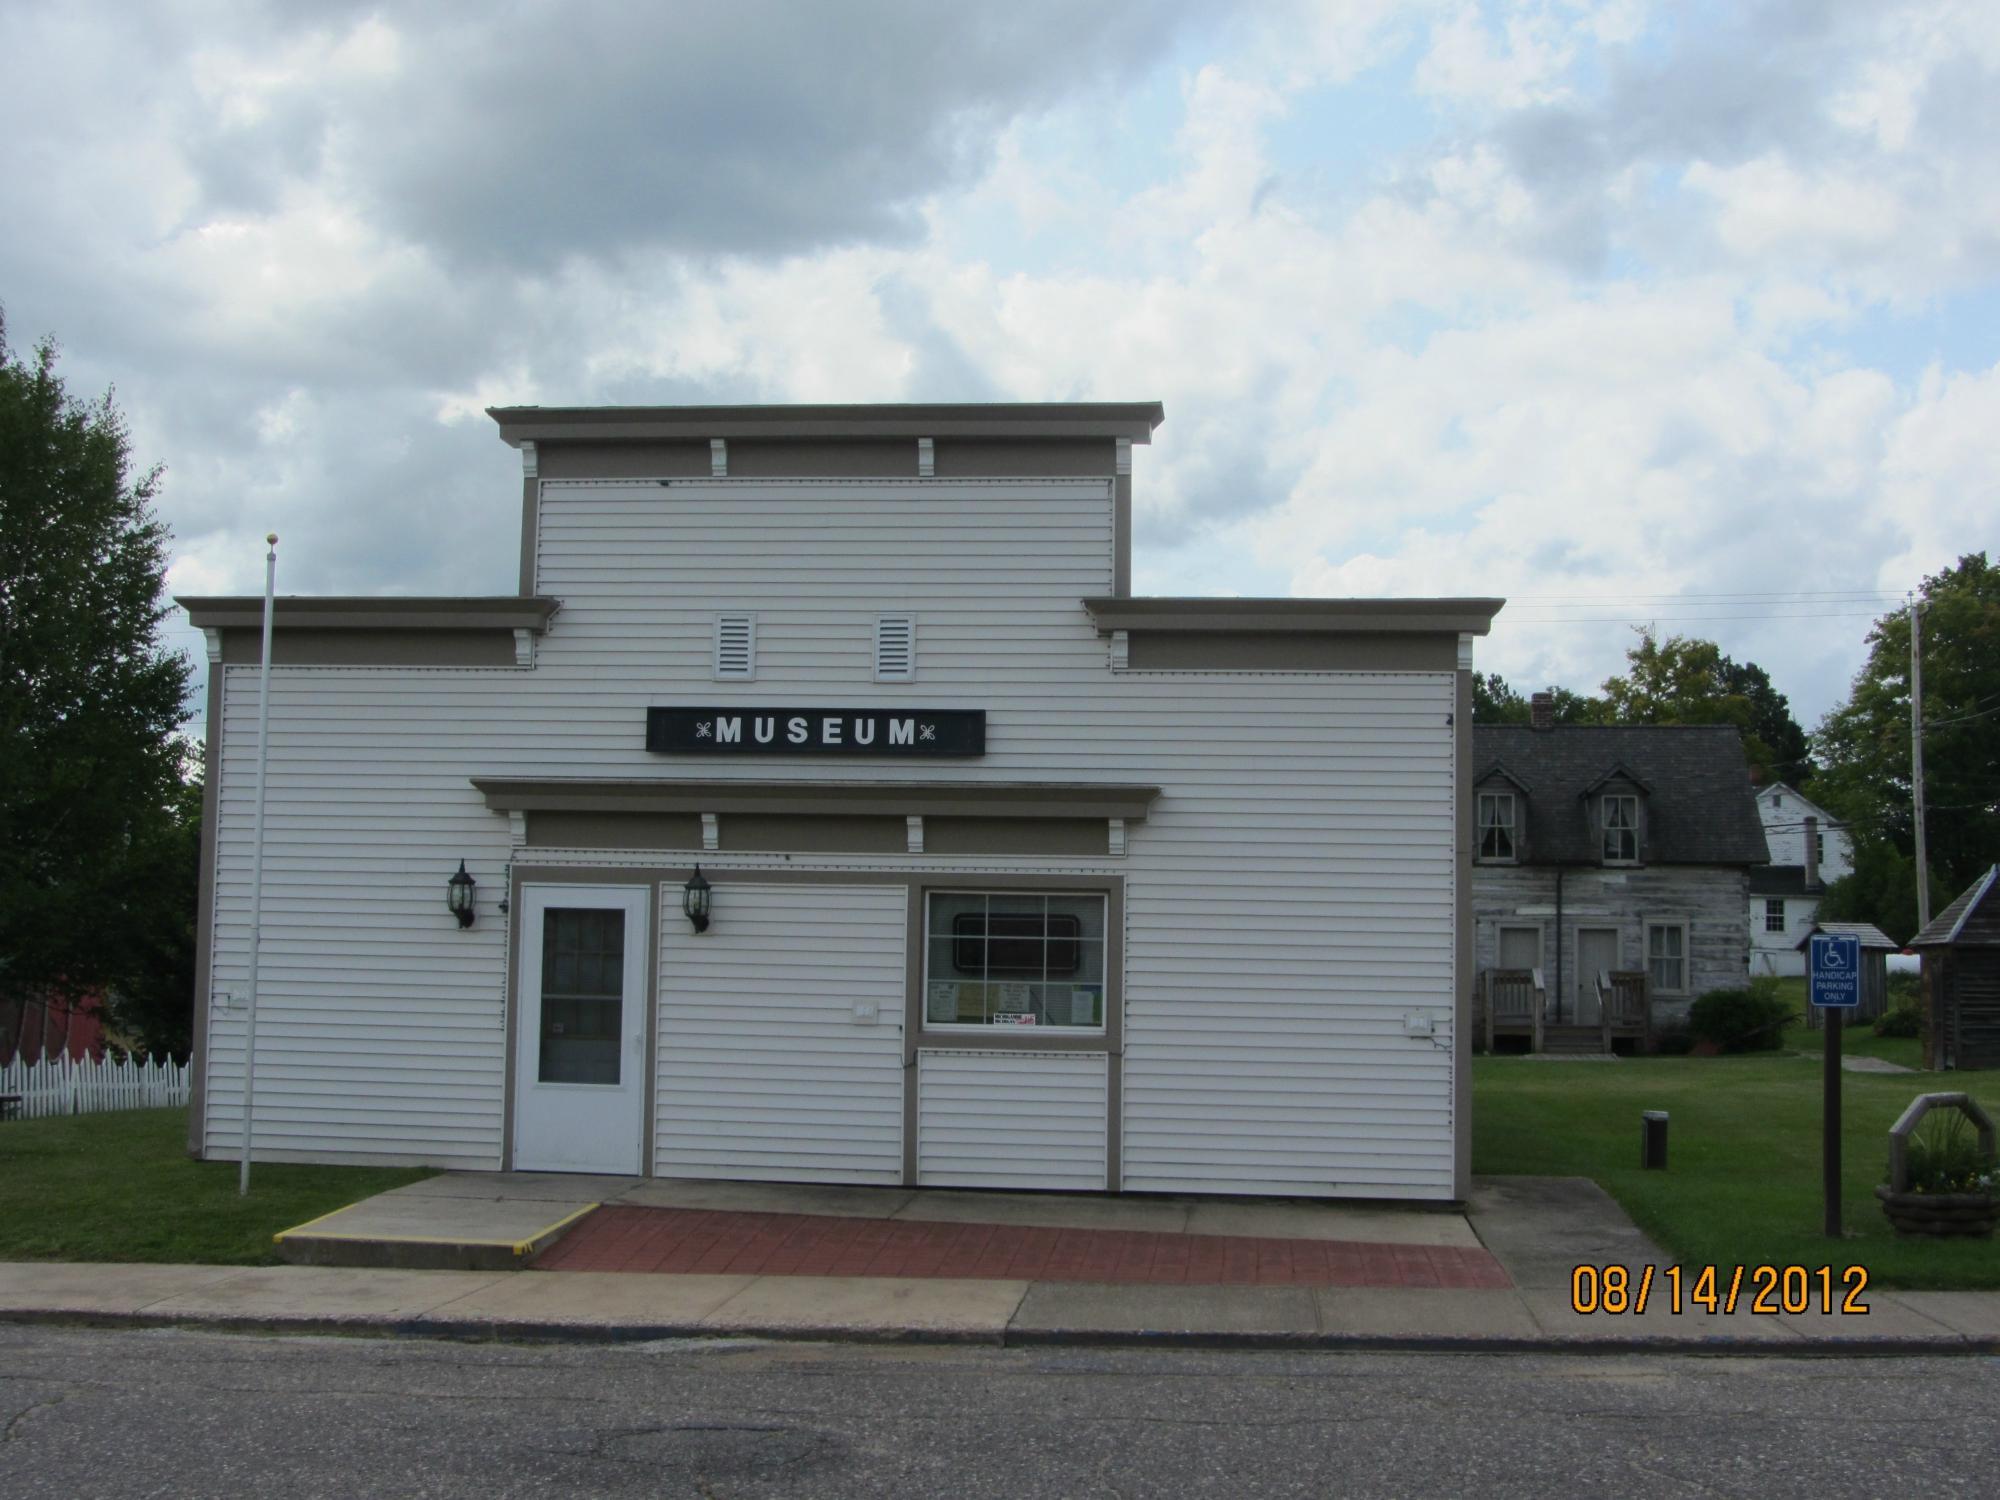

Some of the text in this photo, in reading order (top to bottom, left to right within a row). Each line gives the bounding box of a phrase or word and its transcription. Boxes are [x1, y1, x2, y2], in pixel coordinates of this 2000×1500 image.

[715, 716, 915, 745] MUSEUM
[1812, 970, 1857, 980] HANDICAP
[1816, 981, 1854, 991] PARKING
[1824, 992, 1846, 1001] ONLY
